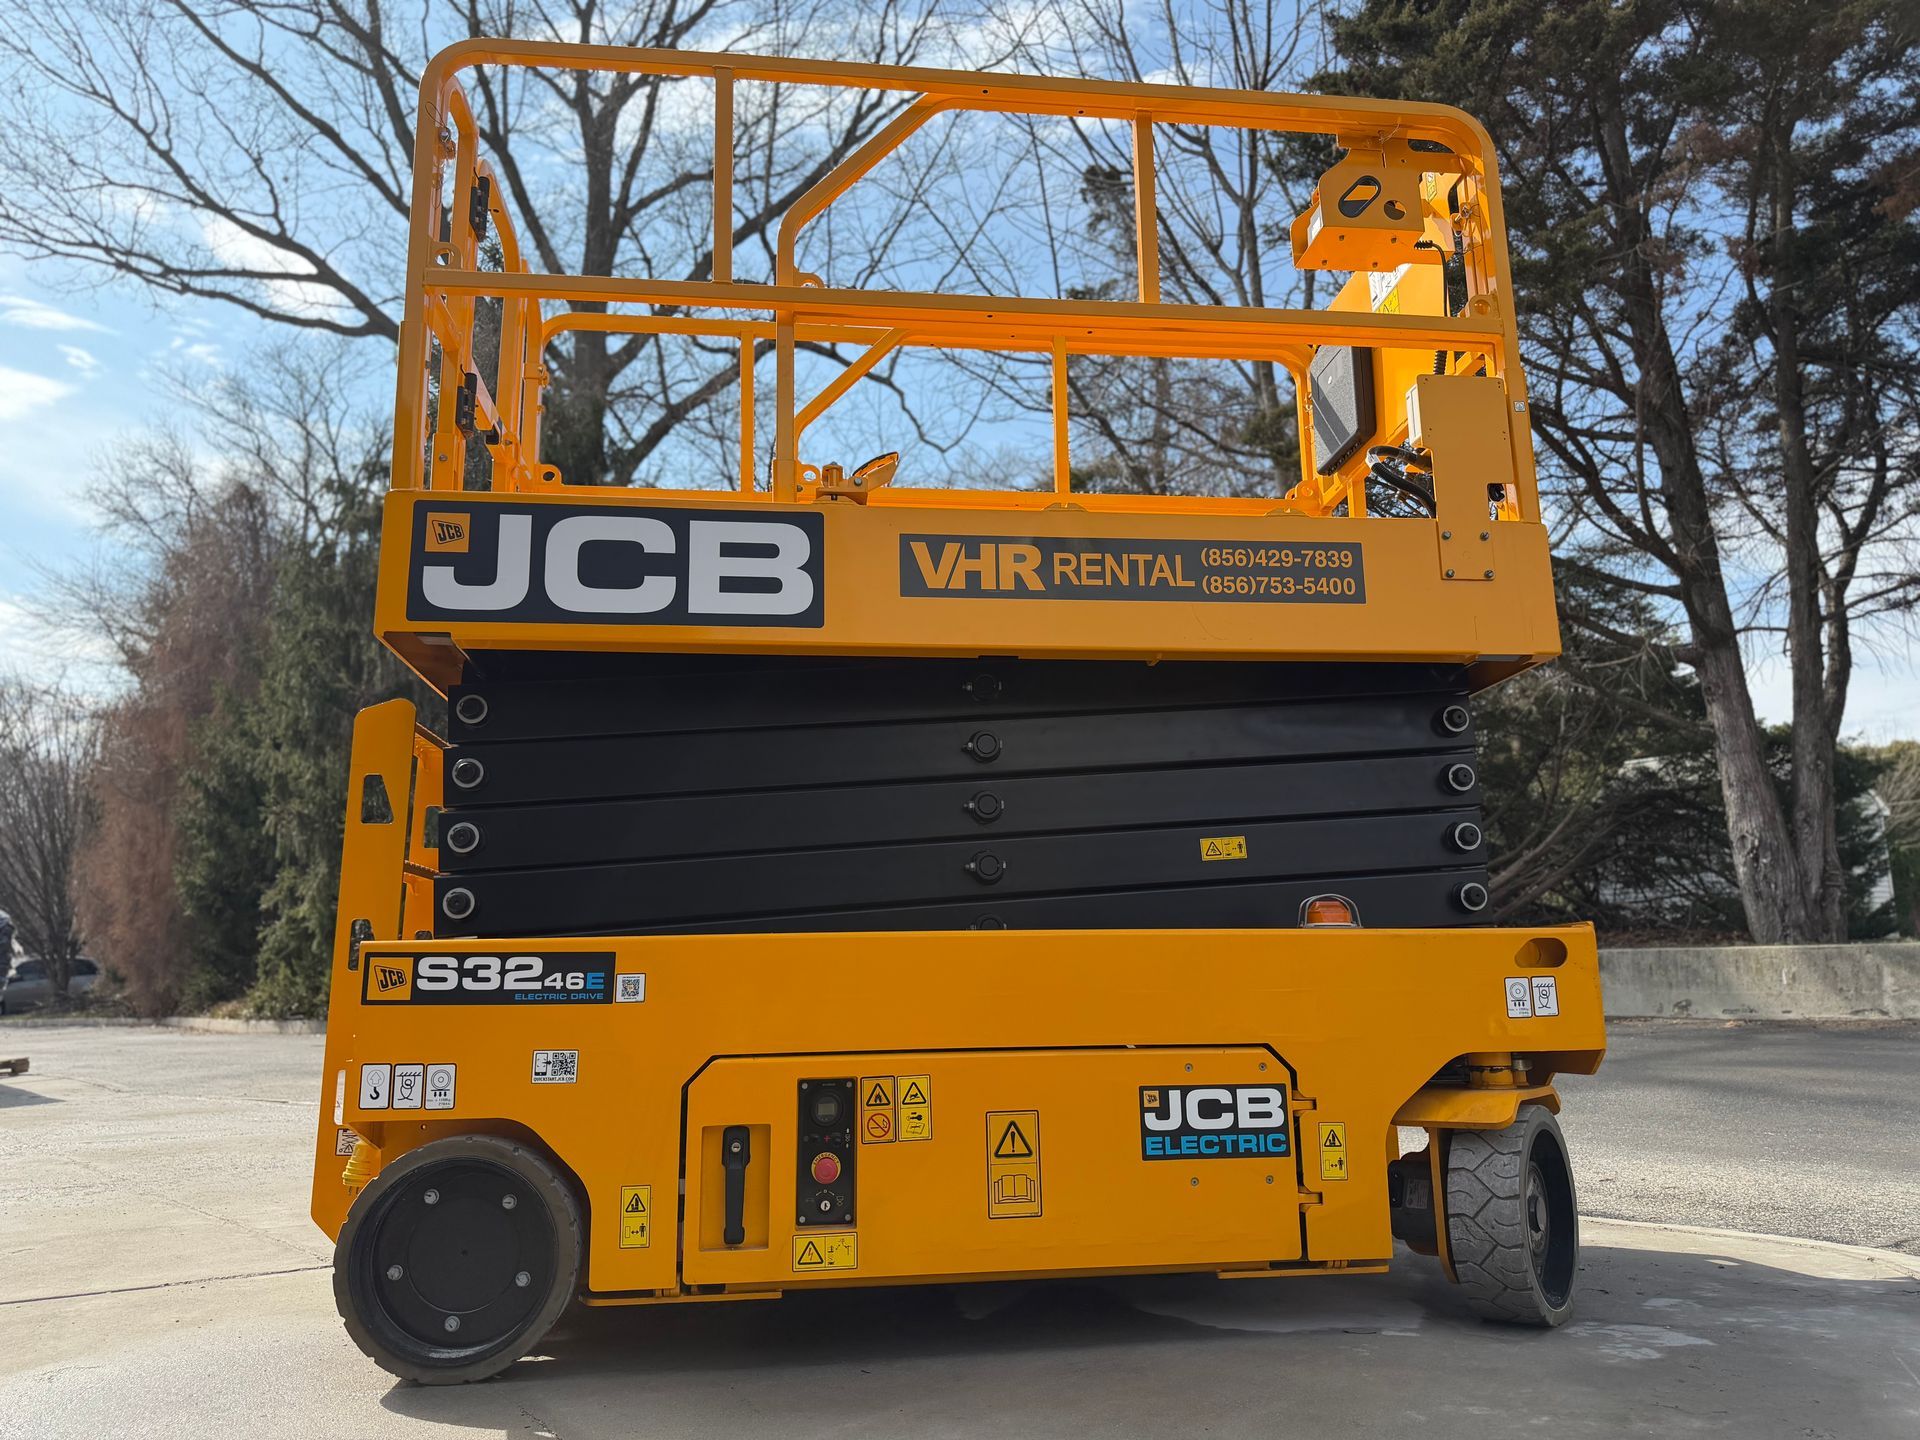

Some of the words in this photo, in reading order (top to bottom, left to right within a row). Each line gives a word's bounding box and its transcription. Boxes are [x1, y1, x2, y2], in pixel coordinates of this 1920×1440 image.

[438, 523, 463, 541] JCB
[422, 513, 814, 615] JCB
[910, 542, 1046, 592] VHR
[1053, 552, 1195, 587] RENTAL
[1200, 548, 1353, 569] (856)429-7839
[1201, 575, 1356, 596] (856)753-5400
[379, 968, 405, 989] JCB
[514, 993, 566, 1001] ELECTRIC
[570, 992, 604, 1001] DRIVE
[1144, 1088, 1285, 1131] JCB
[1146, 1133, 1286, 1155] ELECTRIC
